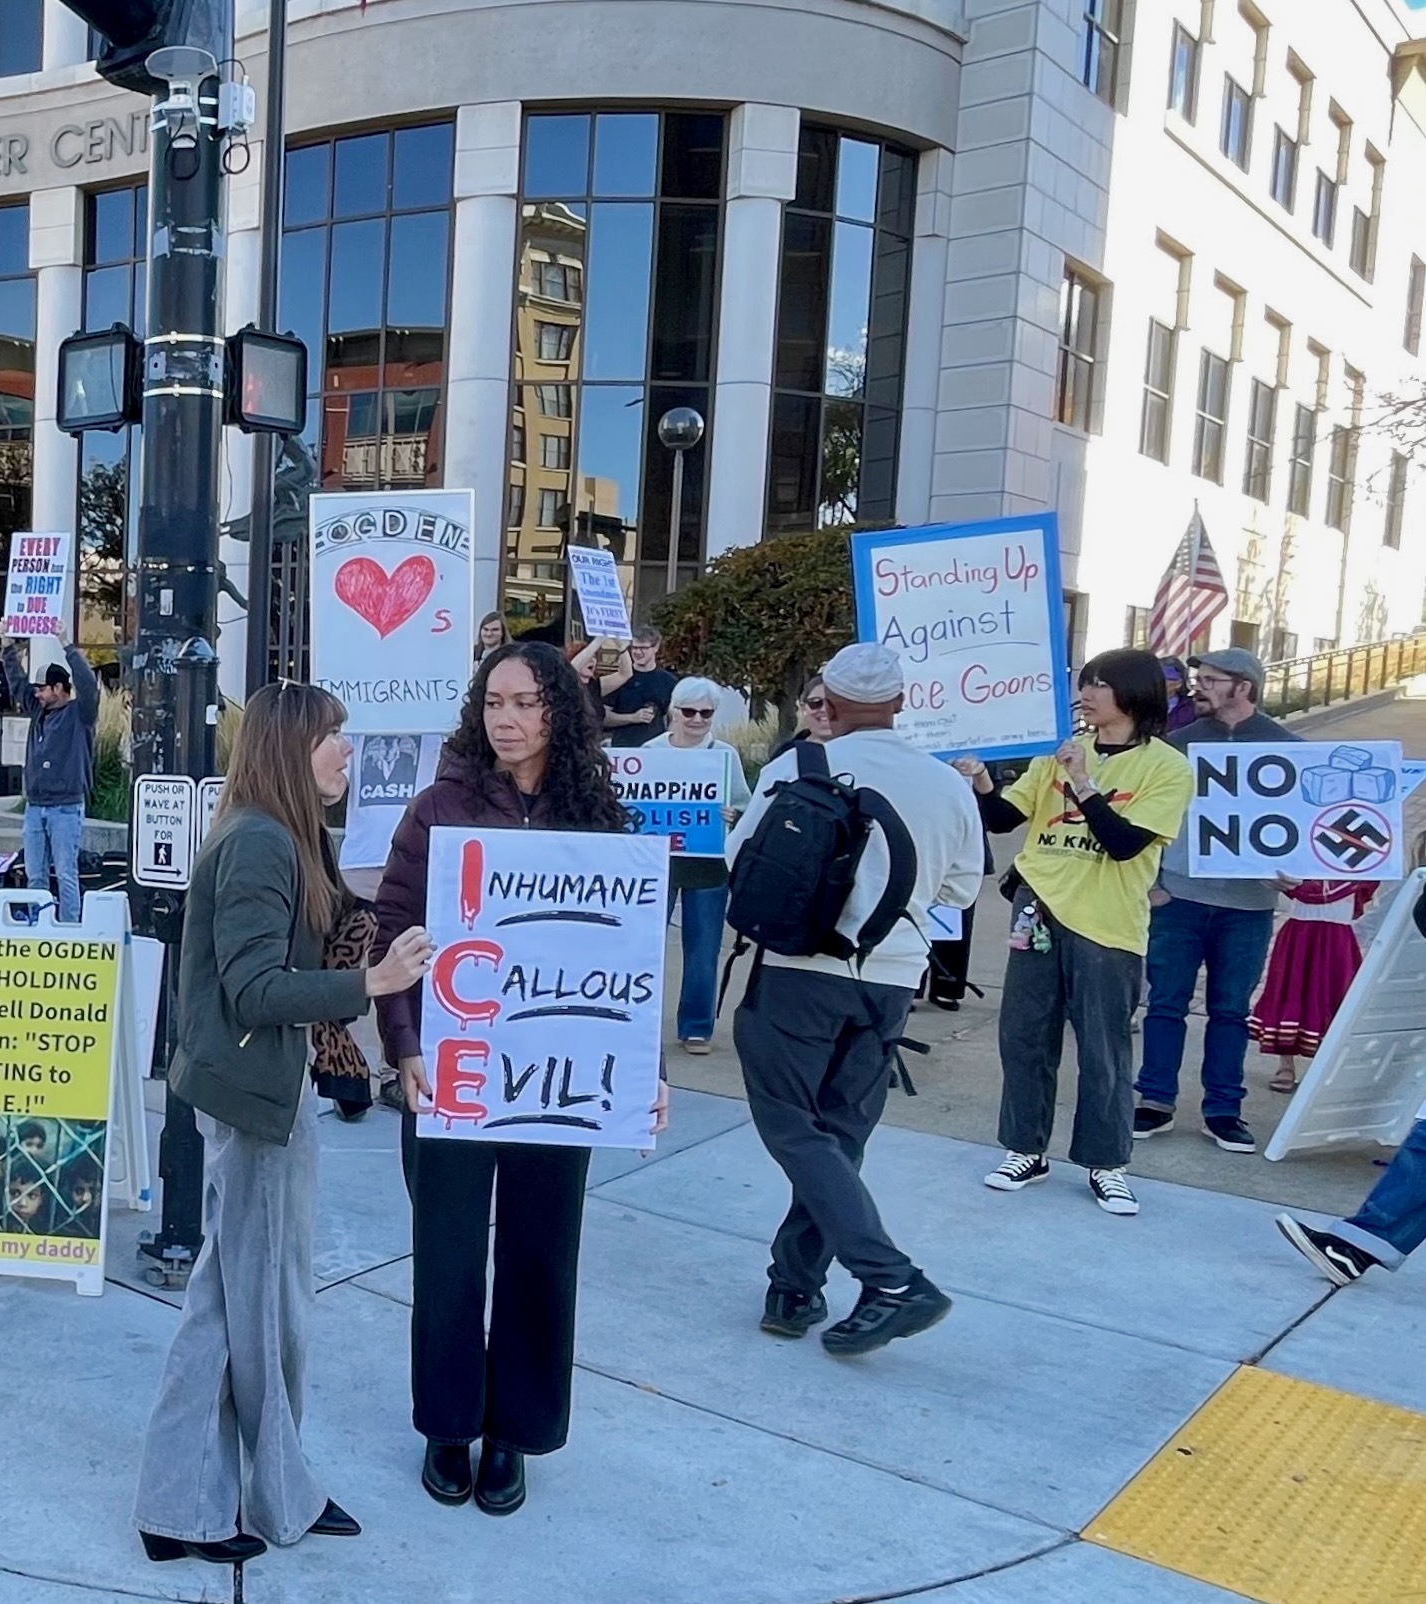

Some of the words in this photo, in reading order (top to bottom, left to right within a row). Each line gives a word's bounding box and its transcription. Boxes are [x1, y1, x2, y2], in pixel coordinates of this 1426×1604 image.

[51, 110, 151, 168] CENT
[326, 509, 462, 550] OGDEN
[20, 538, 61, 556] EVERY
[11, 558, 51, 573] PERSON
[875, 558, 998, 596] Standing
[1004, 545, 1038, 592] Up
[25, 576, 62, 594] RIGHT
[27, 597, 47, 613] DUE
[882, 600, 1015, 663] Against
[316, 678, 459, 702] IMMIGRANTS
[961, 664, 1052, 704] Goons
[1197, 754, 1296, 798] NO
[145, 783, 169, 794] PUSH
[172, 785, 184, 794] OR
[360, 783, 414, 800] CASH
[144, 799, 170, 809] WAVE
[172, 801, 185, 810] AT
[146, 814, 182, 825] BUTTON
[154, 830, 172, 840] FOR
[1038, 833, 1056, 845] NO
[1199, 813, 1299, 857] NO
[37, 941, 116, 961] OGDEN
[29, 1001, 108, 1024] Donald
[25, 1031, 96, 1054] "STOP
[48, 1065, 72, 1084] to
[1, 1238, 30, 1259] my
[35, 1236, 97, 1264] daddy
